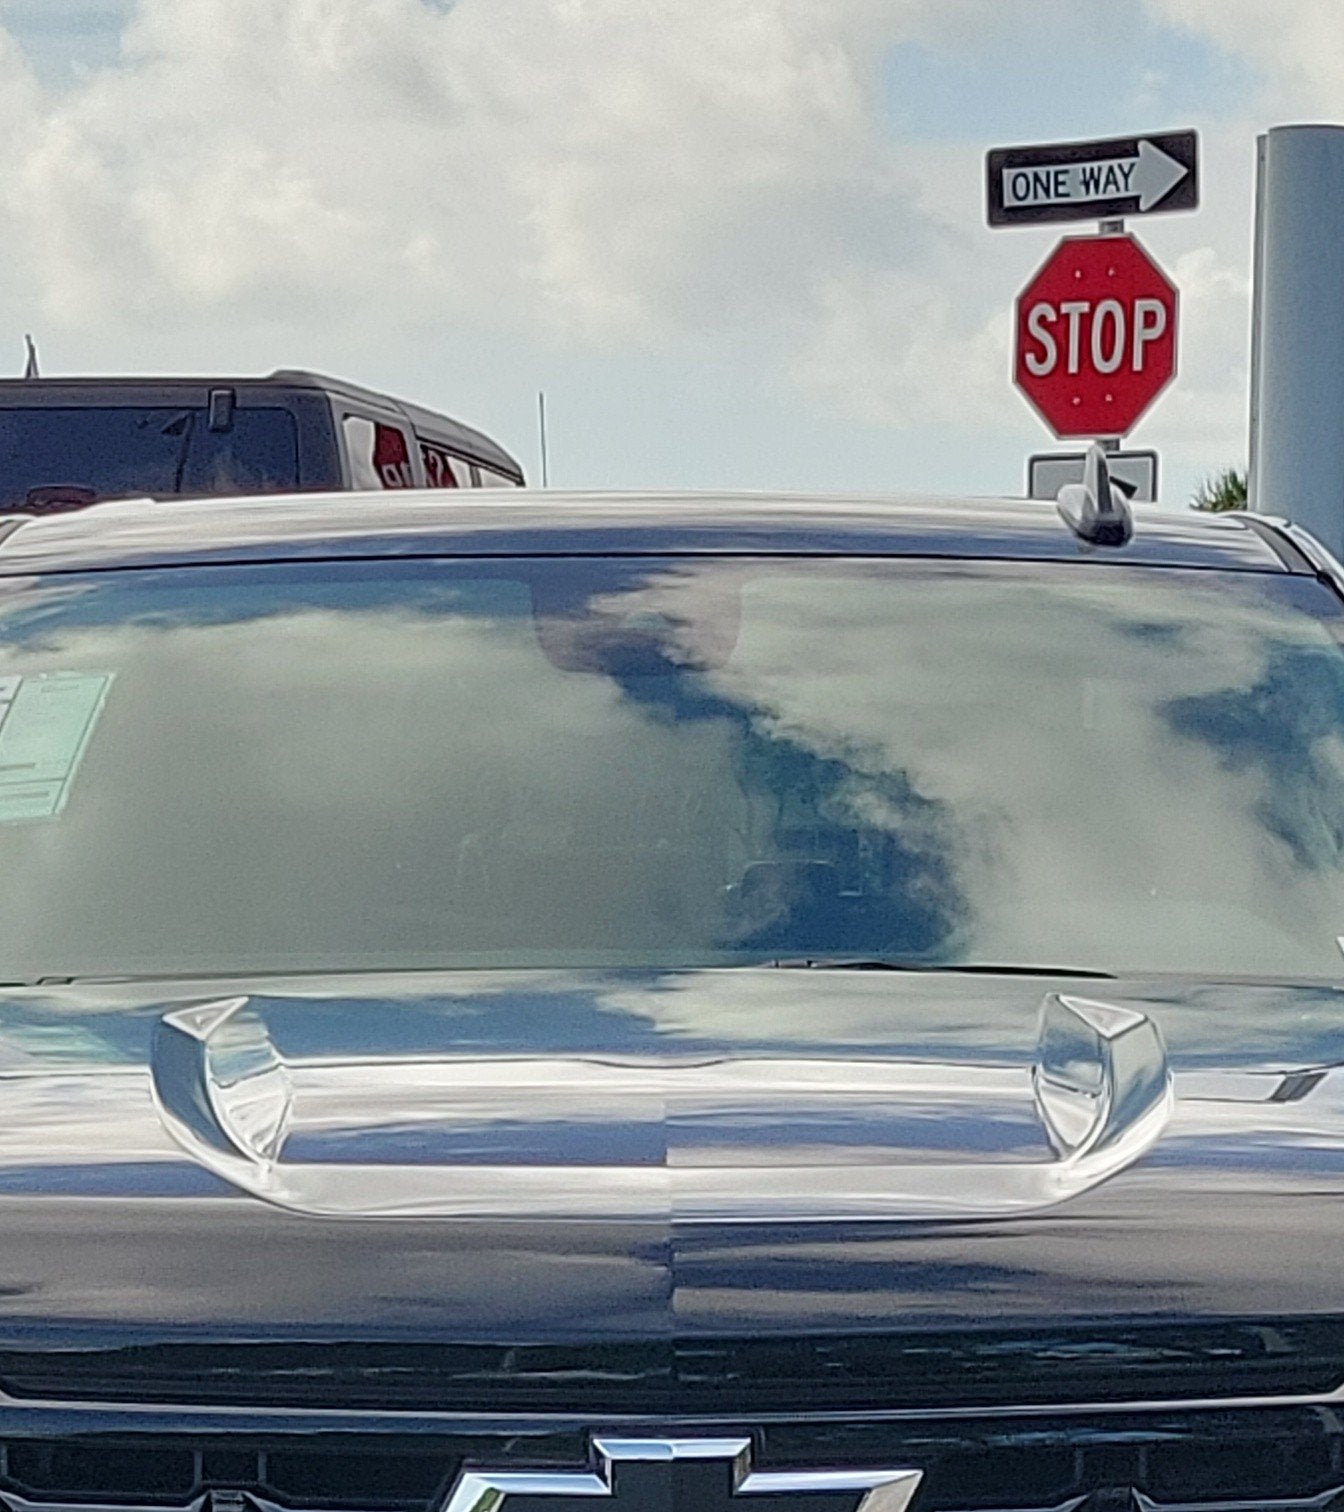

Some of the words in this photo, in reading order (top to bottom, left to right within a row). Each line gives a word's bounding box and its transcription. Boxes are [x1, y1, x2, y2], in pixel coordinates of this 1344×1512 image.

[1011, 169, 1071, 201] ONE
[1081, 162, 1137, 196] WAY
[1024, 299, 1167, 375] STOP
